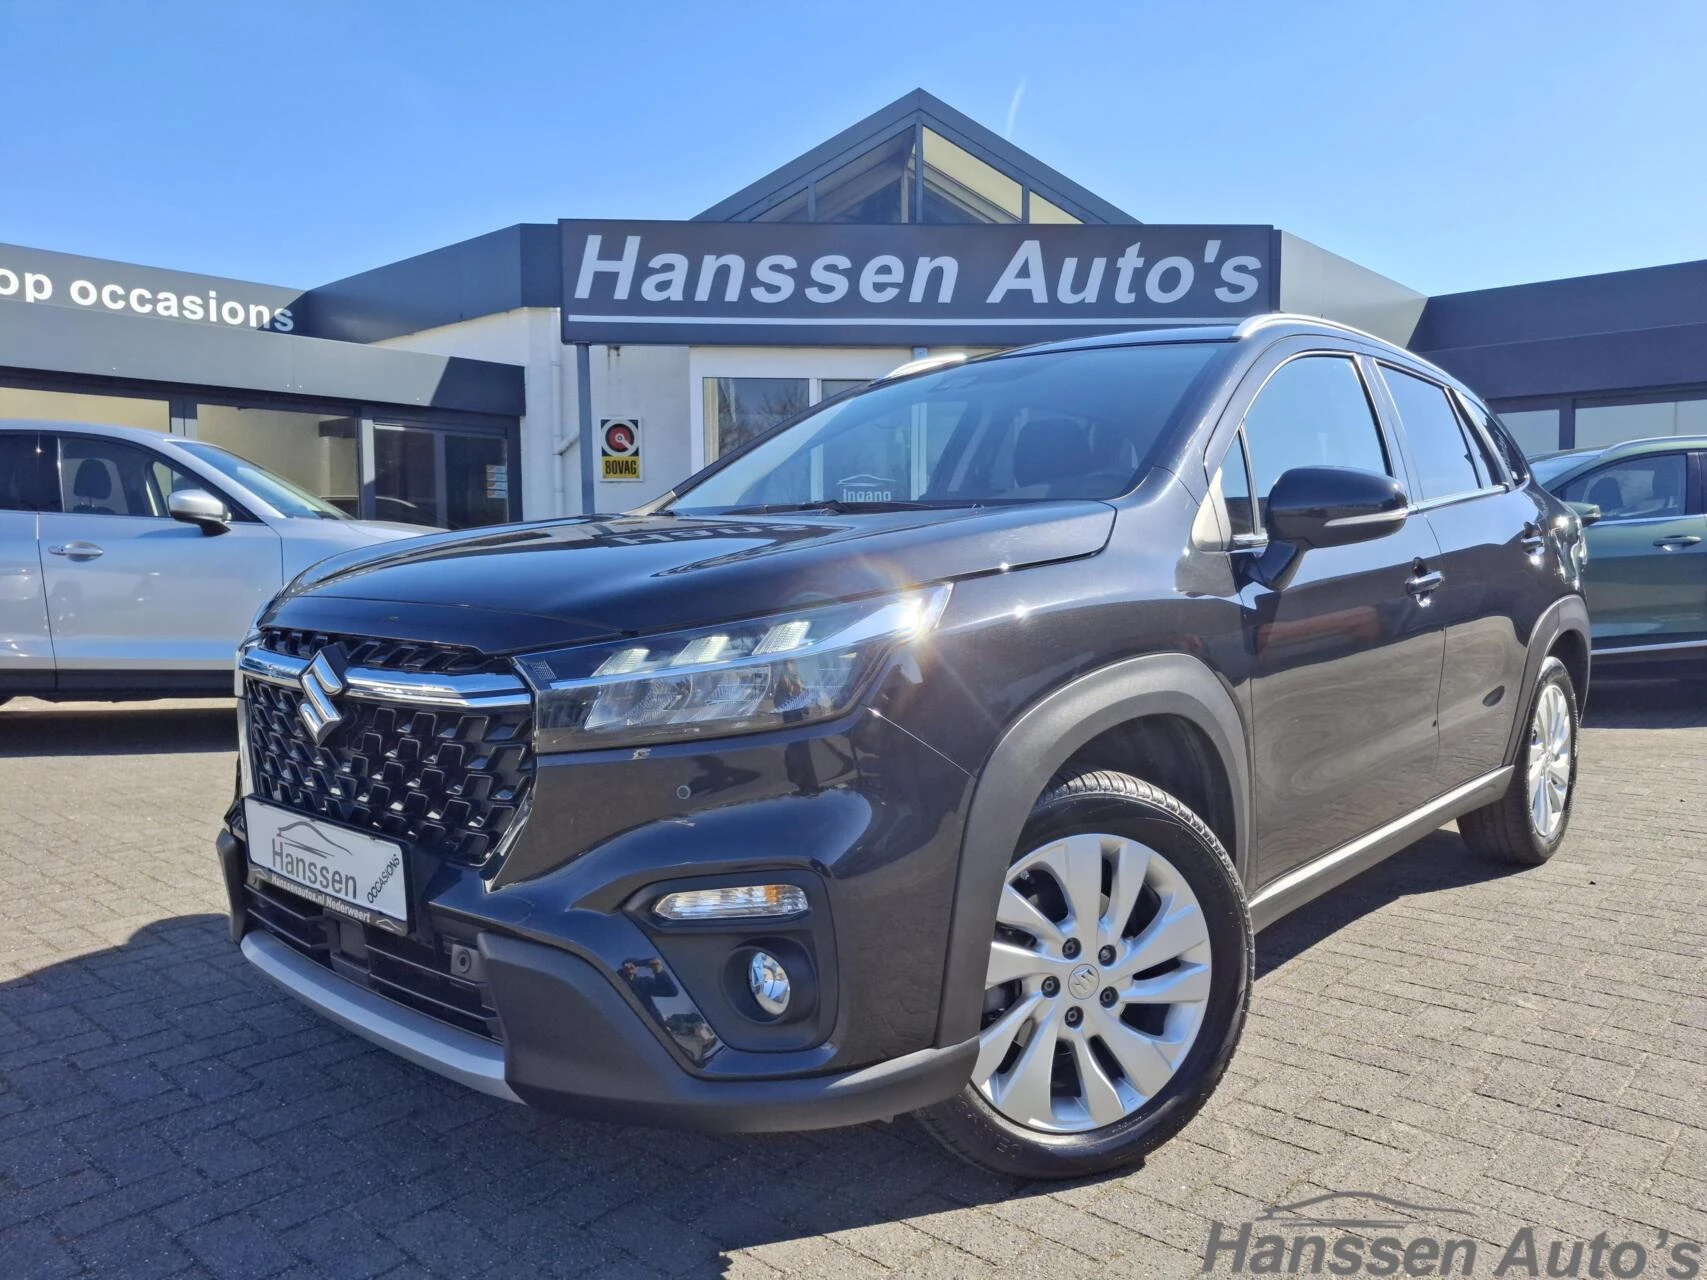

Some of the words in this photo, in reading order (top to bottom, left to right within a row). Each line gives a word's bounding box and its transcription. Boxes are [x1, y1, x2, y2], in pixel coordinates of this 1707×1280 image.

[574, 234, 959, 304] Hanssen
[985, 239, 1263, 305] Auto's
[70, 279, 294, 332] occasions
[605, 460, 637, 475] BOVAG
[272, 838, 357, 900] Hanssen
[367, 853, 400, 904] OCCASIONS
[326, 895, 371, 923] Nederweert
